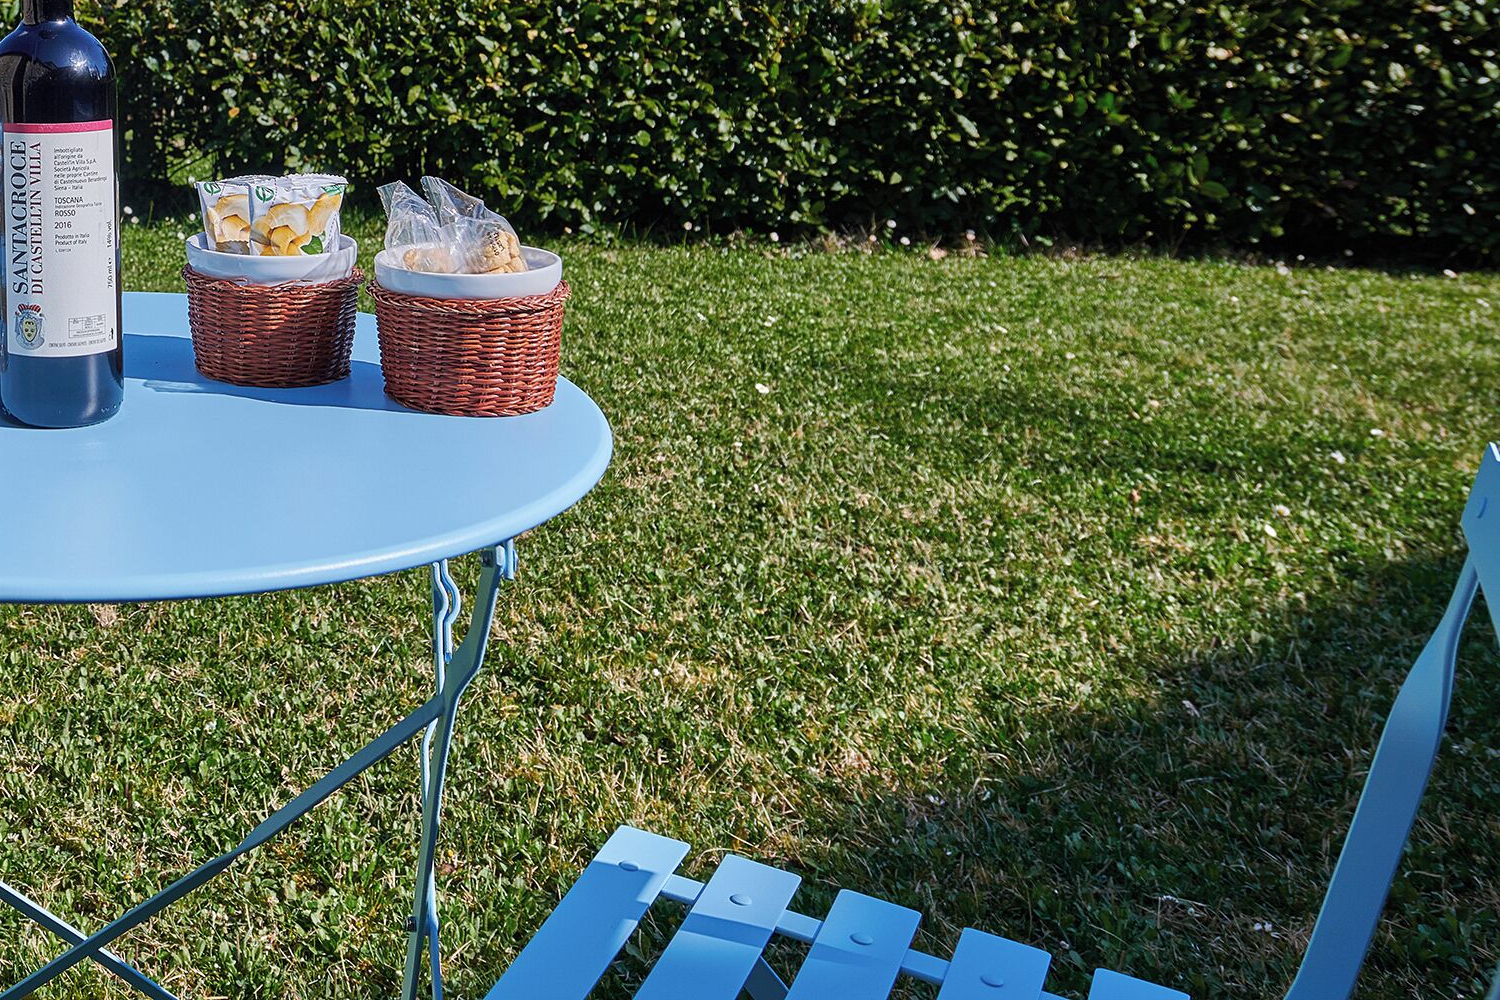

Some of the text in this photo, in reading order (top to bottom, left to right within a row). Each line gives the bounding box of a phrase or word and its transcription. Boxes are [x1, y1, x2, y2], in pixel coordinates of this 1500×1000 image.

[10, 141, 29, 295] SANTACROCE
[29, 142, 43, 295] DI CASTELL'IN VILLA
[55, 209, 76, 217] ROSSO
[55, 221, 72, 229] 2016
